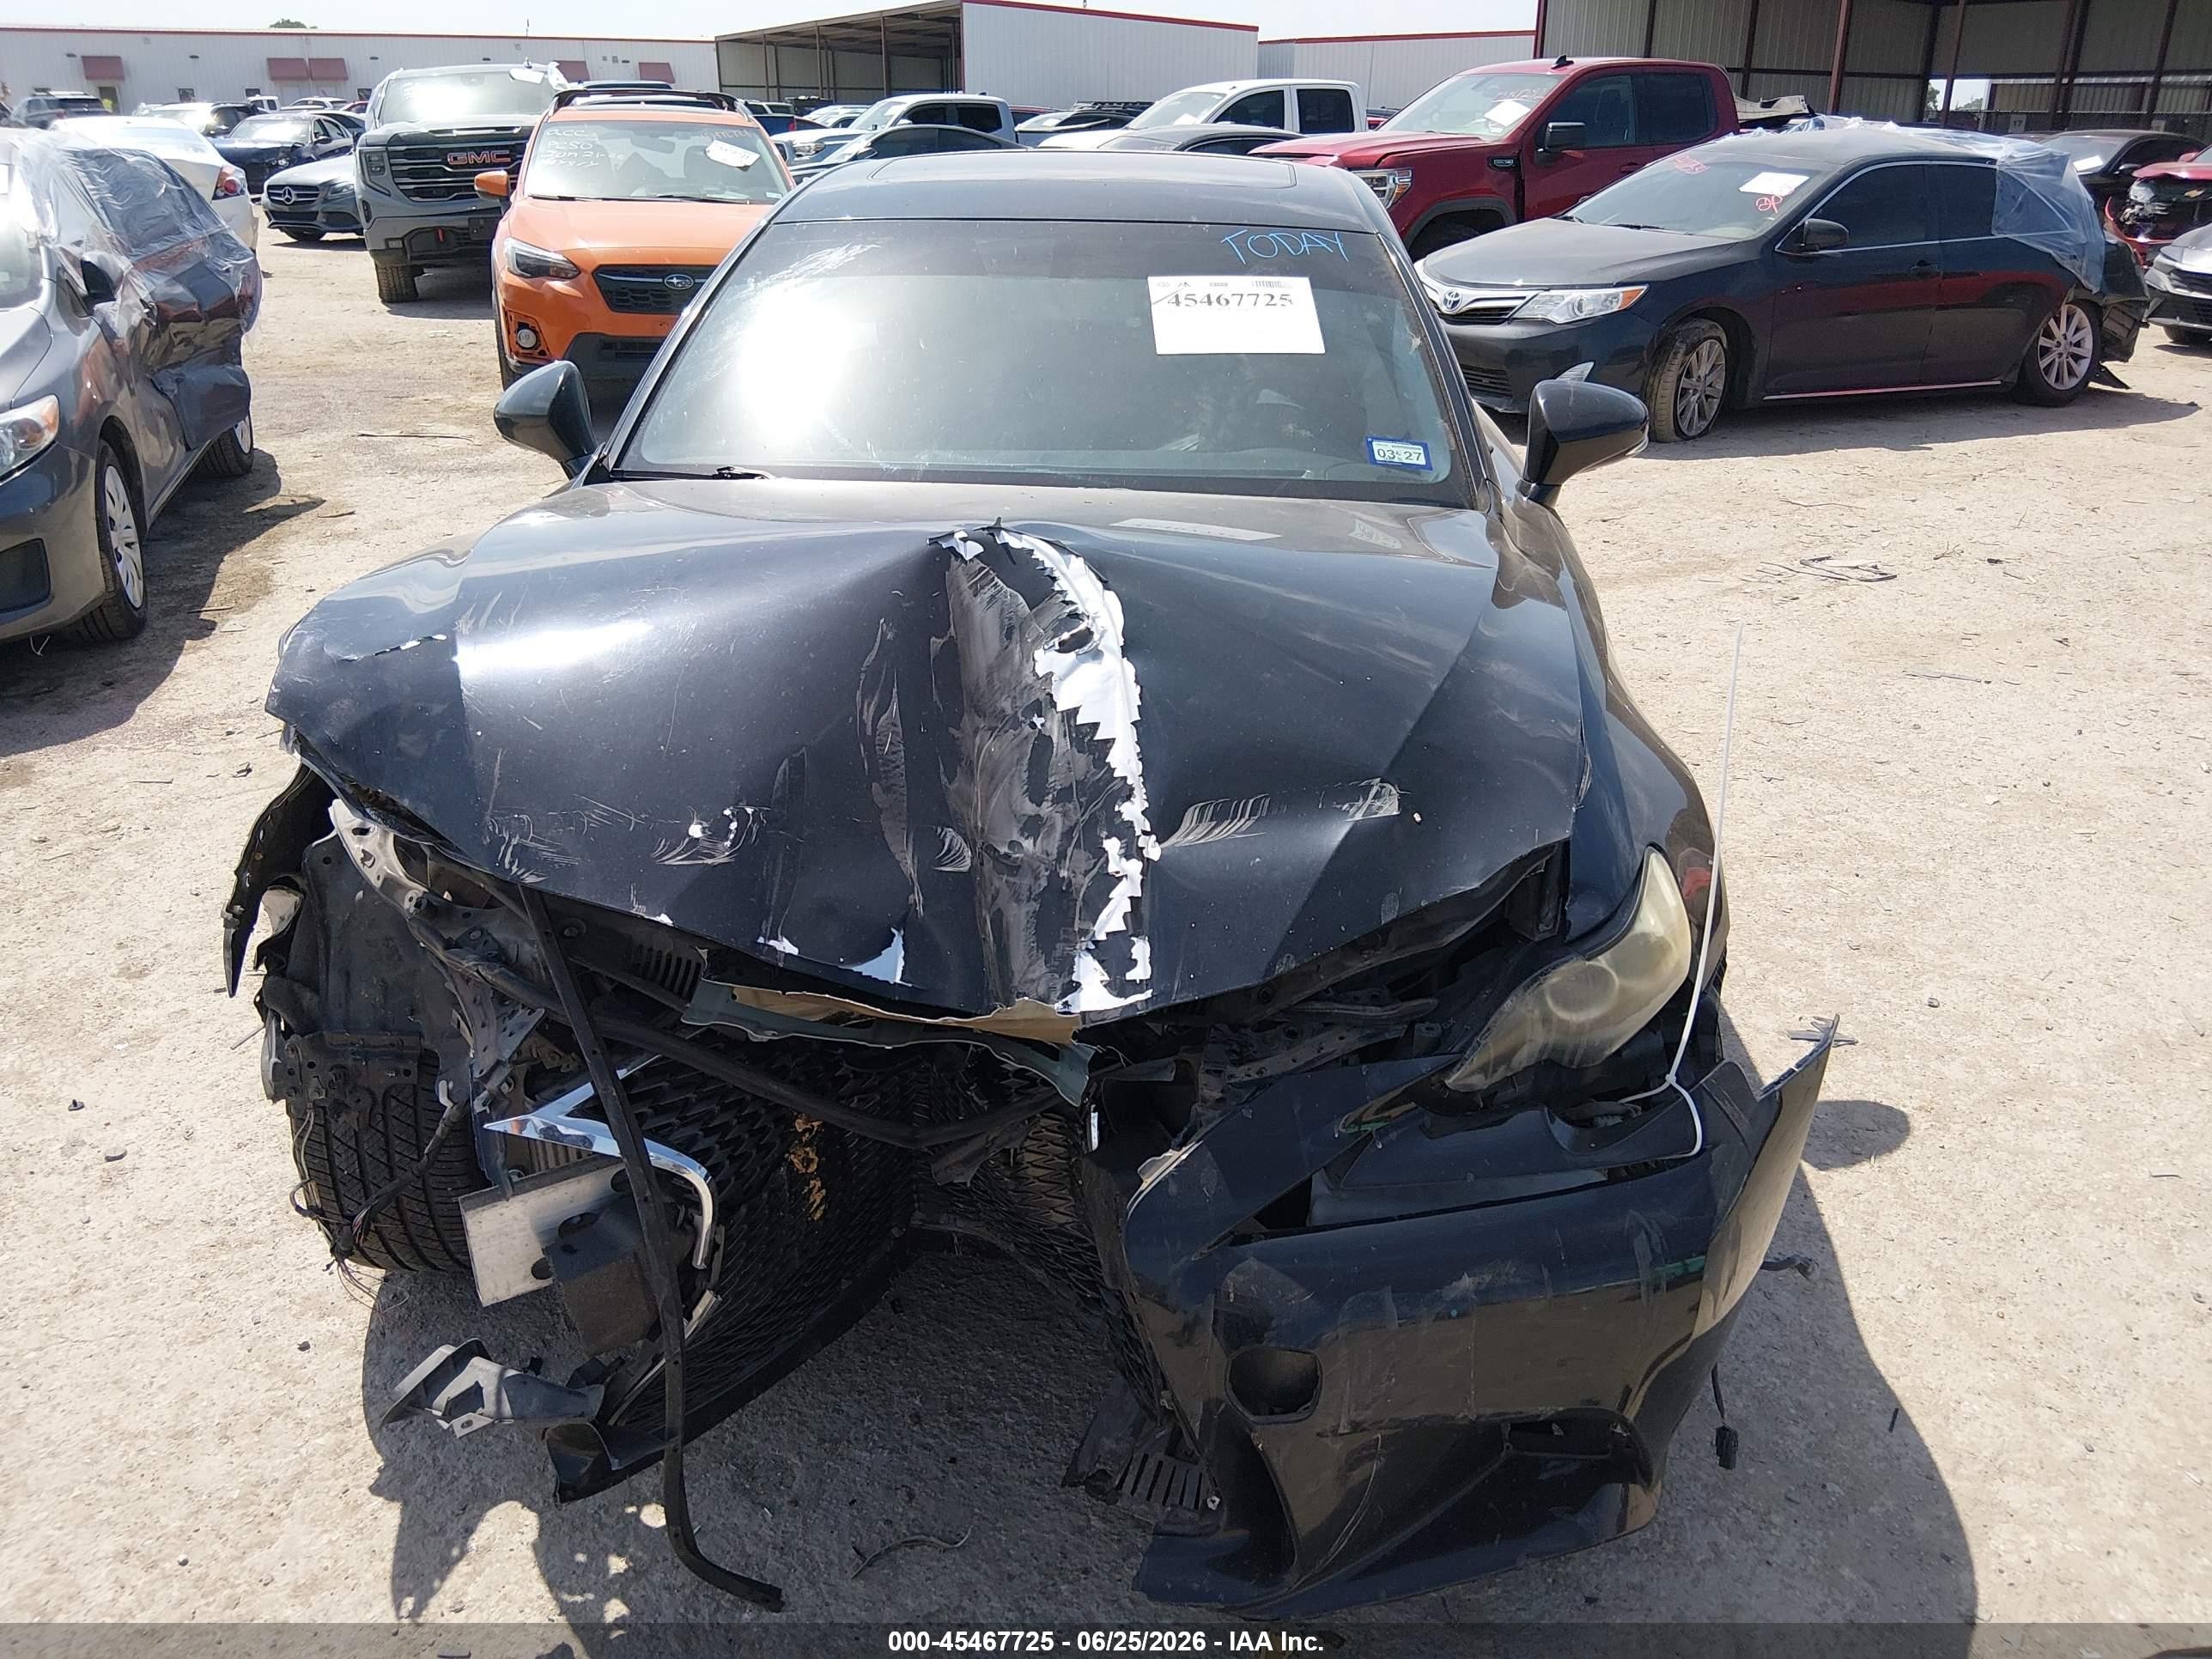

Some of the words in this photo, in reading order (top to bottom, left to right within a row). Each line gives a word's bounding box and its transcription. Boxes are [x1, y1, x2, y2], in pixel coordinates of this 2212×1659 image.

[447, 149, 511, 165] GMC
[1220, 229, 1349, 264] TODAY
[1167, 293, 1294, 307] 45467725
[1377, 448, 1396, 460] 03
[1403, 450, 1422, 461] 27
